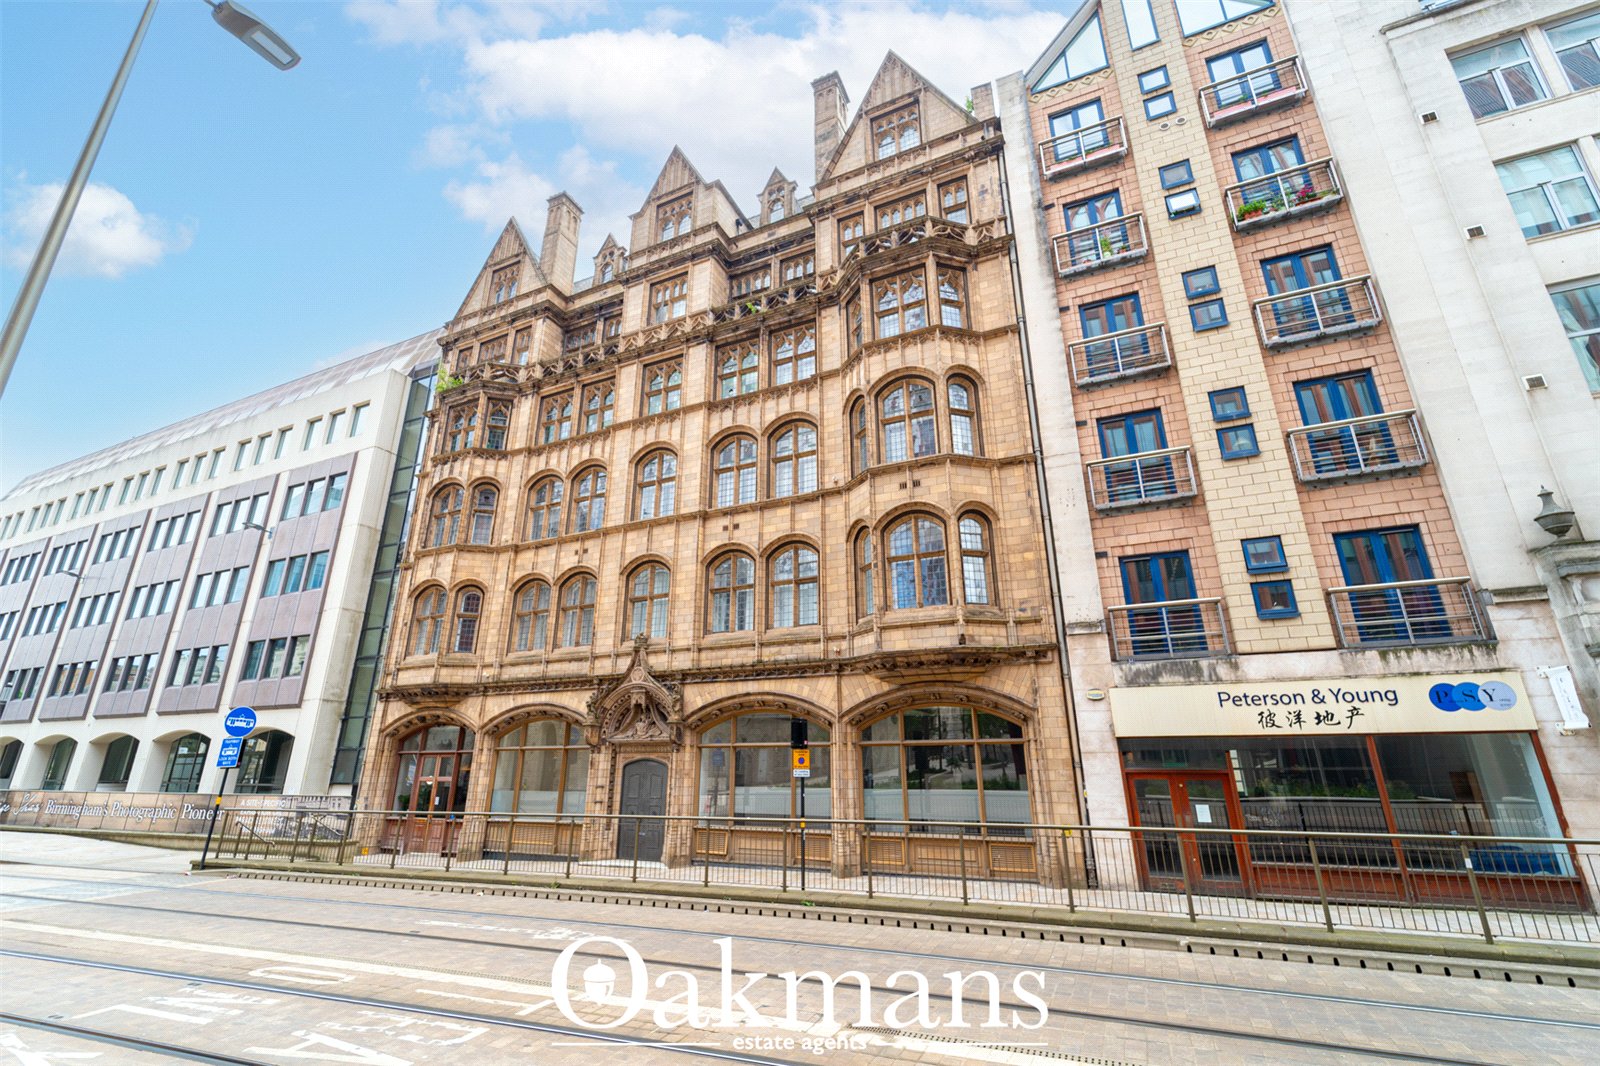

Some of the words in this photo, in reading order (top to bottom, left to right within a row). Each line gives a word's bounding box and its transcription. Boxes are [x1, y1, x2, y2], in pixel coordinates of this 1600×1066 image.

[1217, 691, 1306, 708] Peterson
[1311, 688, 1327, 705] &
[1328, 687, 1399, 707] Young
[1257, 706, 1365, 730] 彼洋地产
[45, 799, 109, 820] Birmingham's
[110, 800, 177, 823] Photographic
